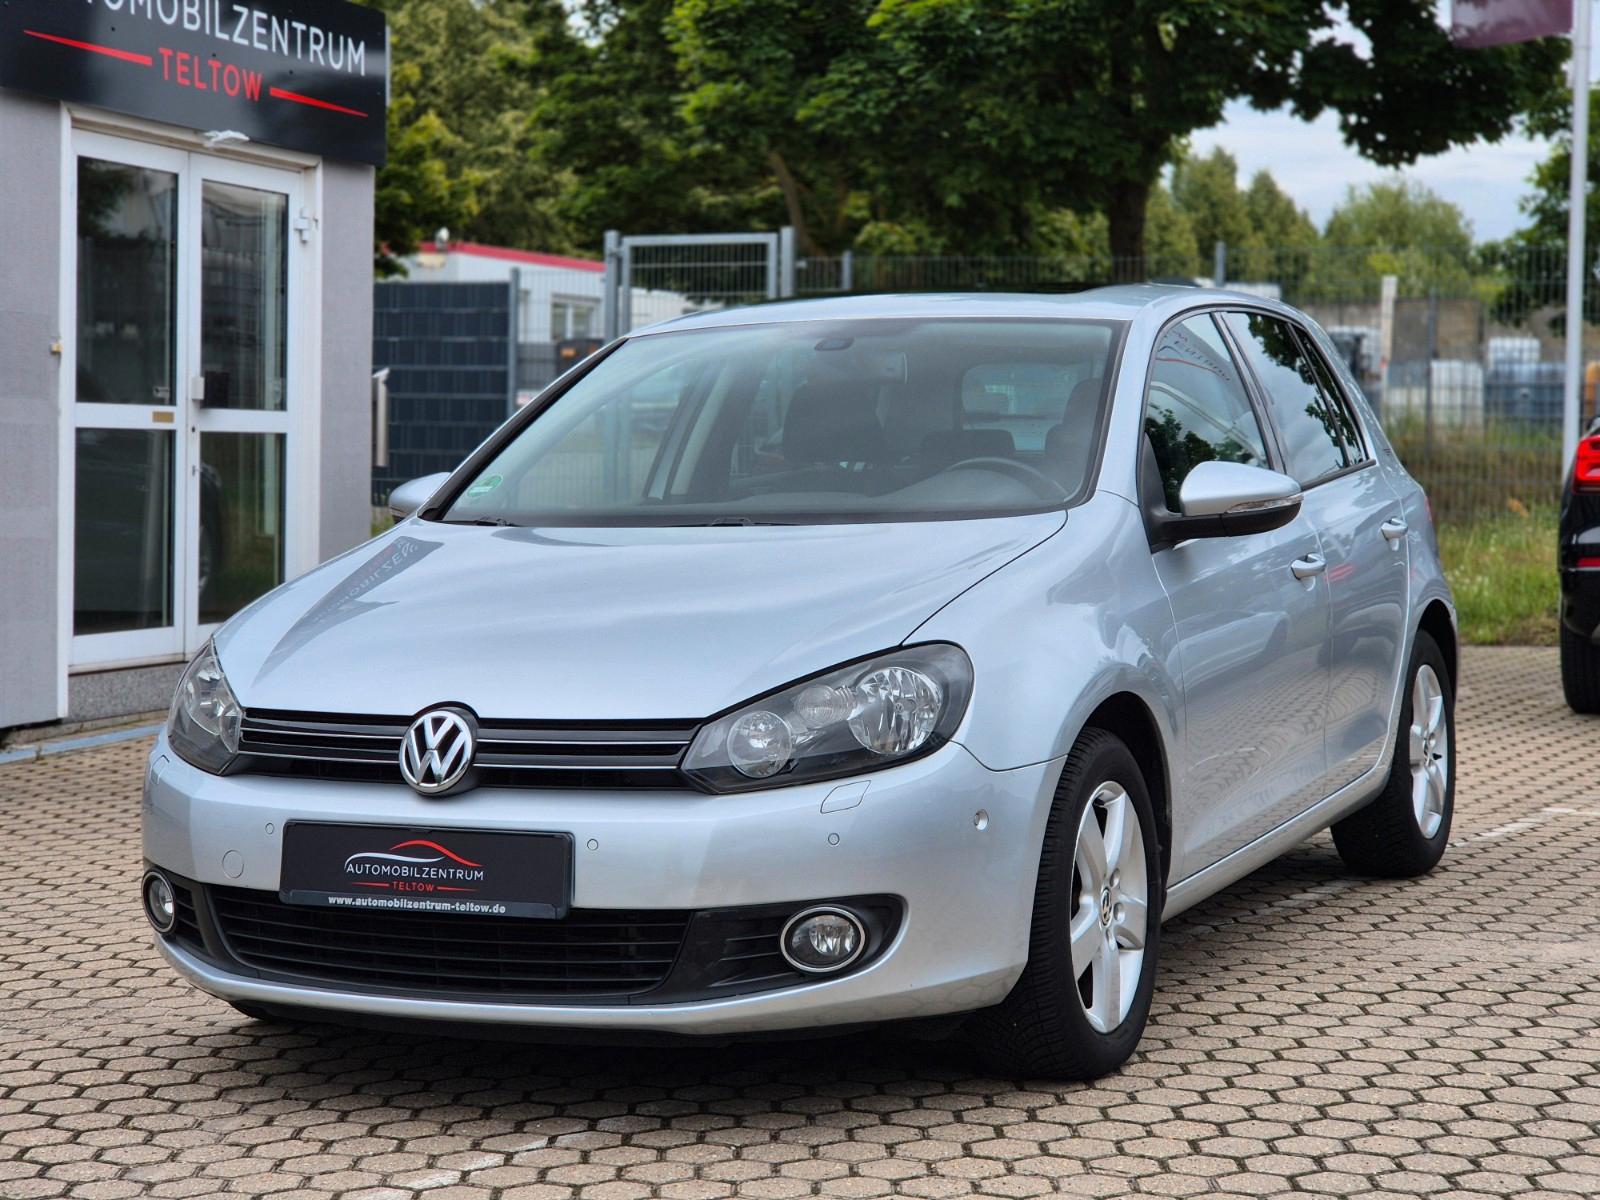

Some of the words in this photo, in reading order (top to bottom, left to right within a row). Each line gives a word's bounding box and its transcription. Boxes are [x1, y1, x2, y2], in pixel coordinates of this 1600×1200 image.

[87, 0, 366, 76] MOBILZENTRUM
[159, 47, 262, 102] TELTOW
[400, 710, 472, 793] VW
[346, 863, 484, 881] AUTOMOBILZENTRUM
[392, 881, 434, 892] TELTOW
[328, 895, 506, 914] www.automobilzentrum-teltow.de
